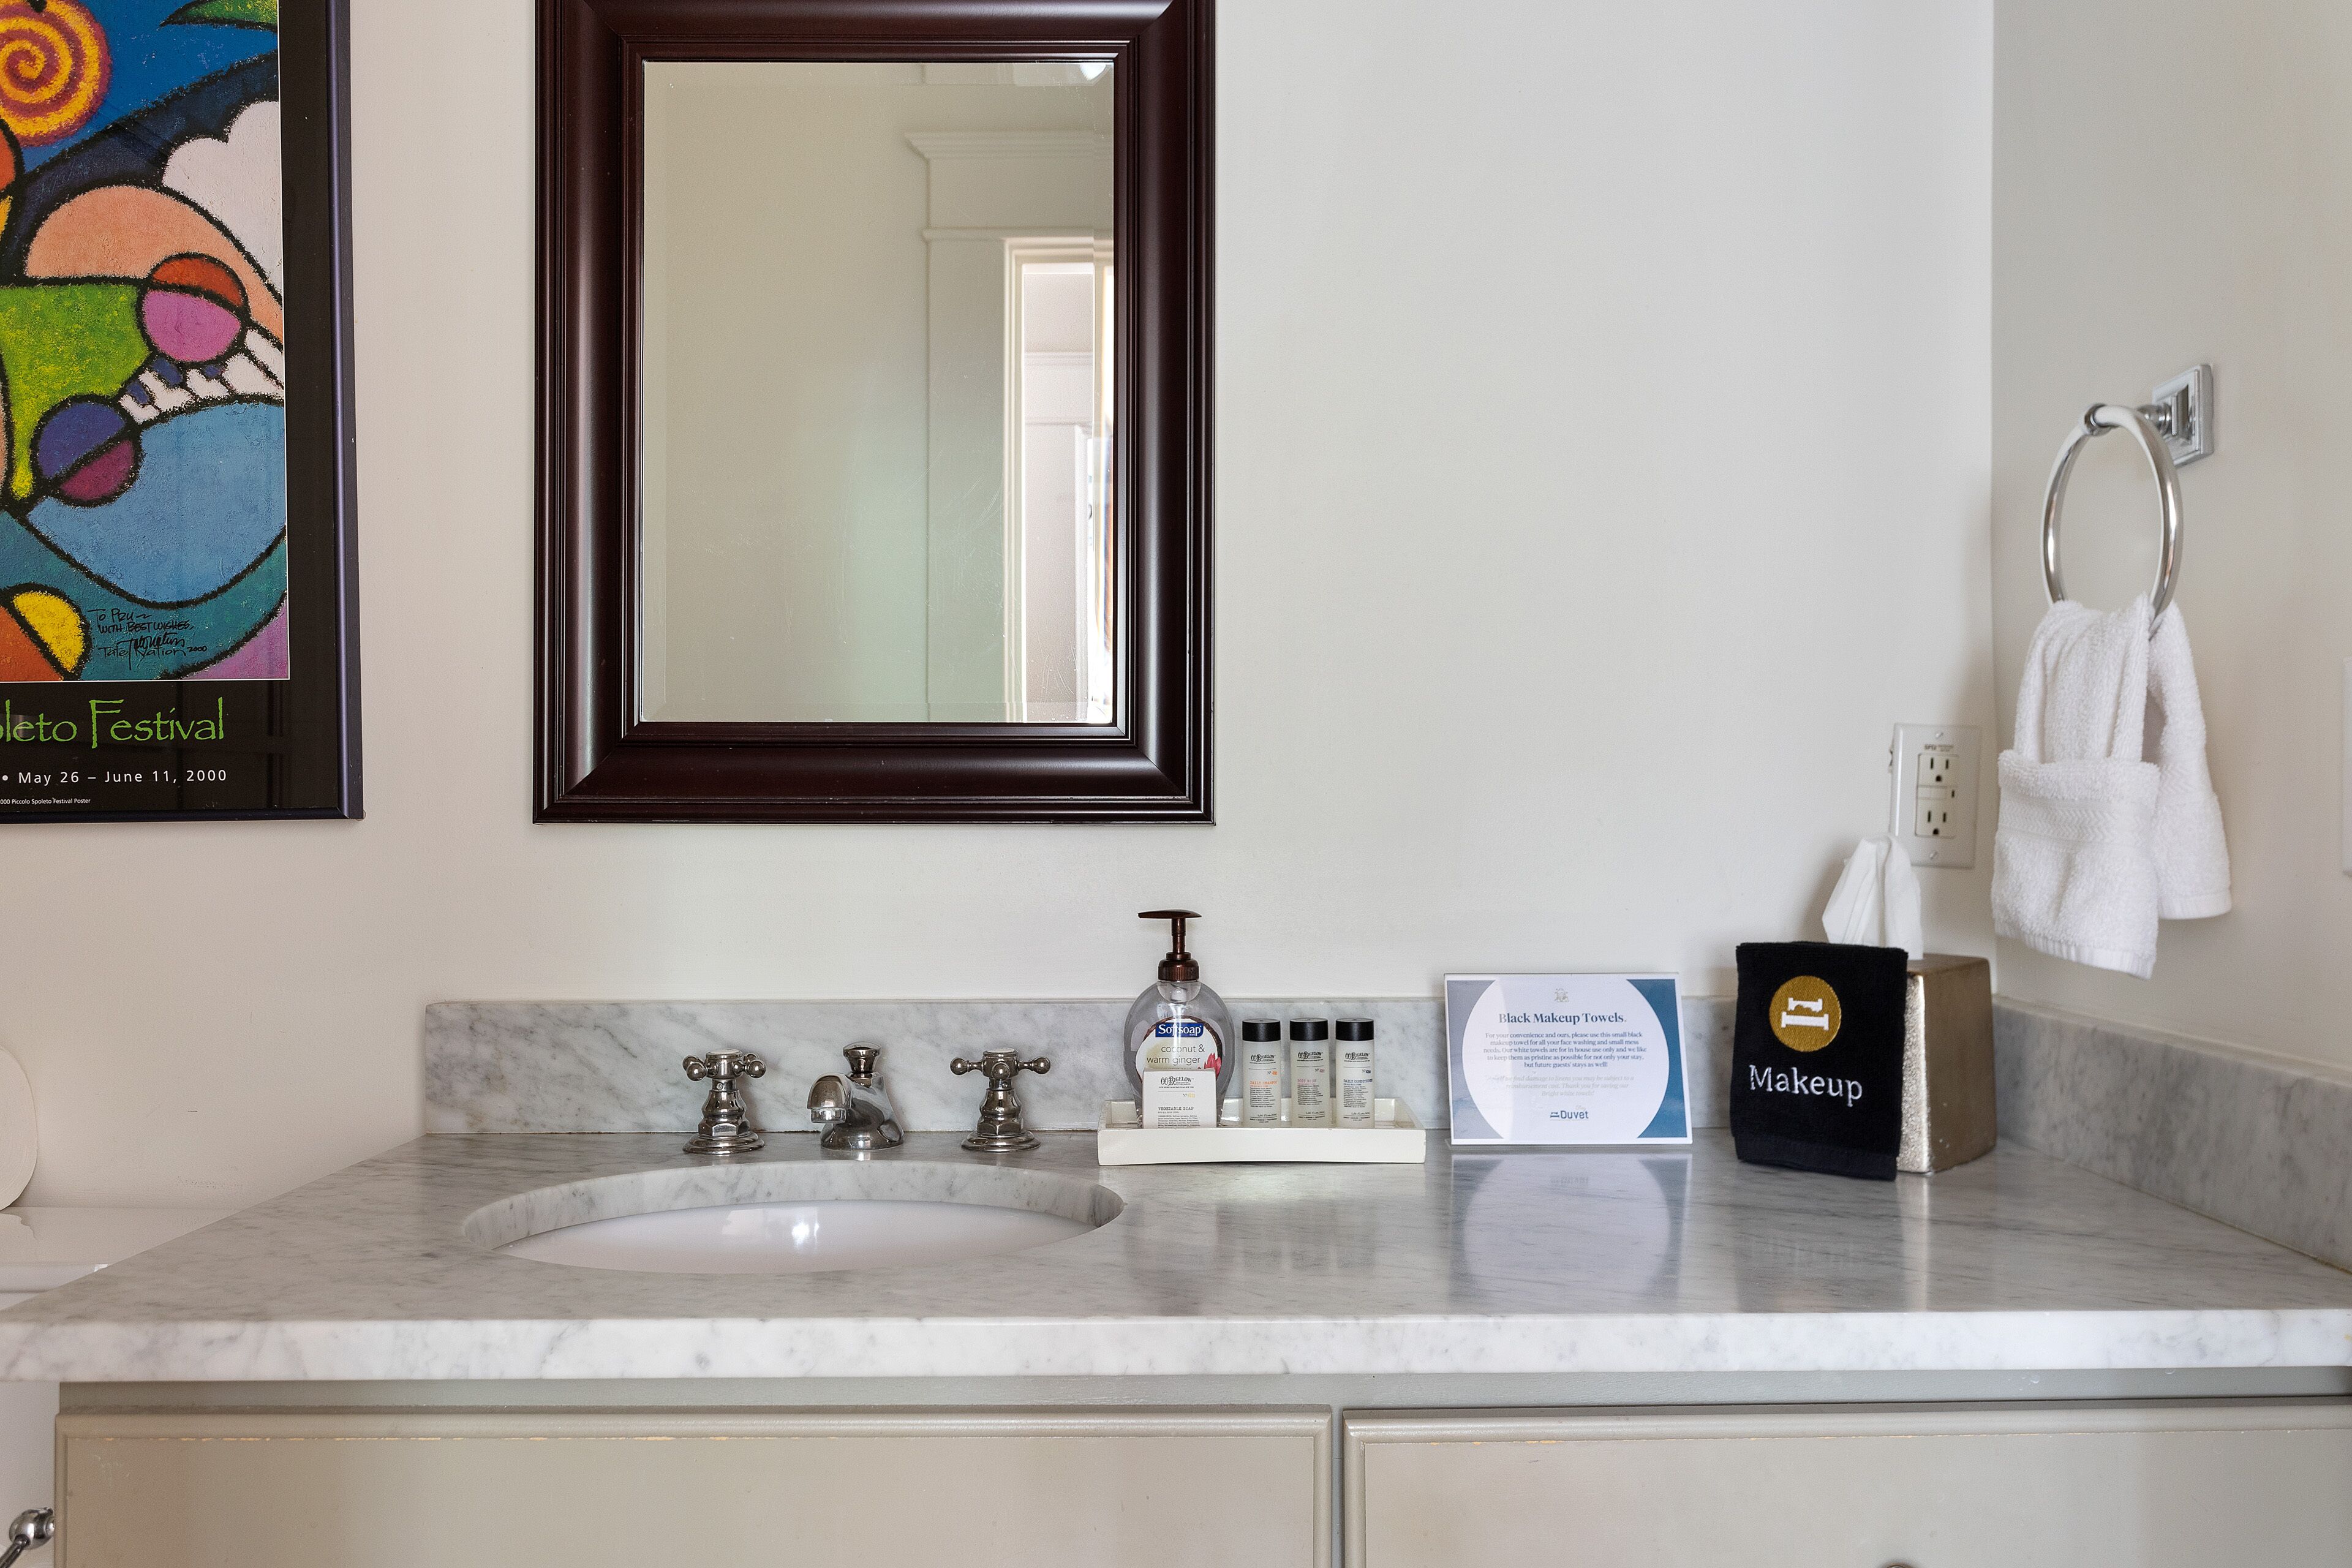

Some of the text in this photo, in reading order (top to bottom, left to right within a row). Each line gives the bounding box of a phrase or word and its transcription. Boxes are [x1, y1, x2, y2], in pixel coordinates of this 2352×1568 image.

[0, 696, 224, 748] leto Festival
[18, 772, 51, 786] May
[60, 771, 79, 783] 26
[105, 771, 142, 783] June
[153, 770, 177, 783] 11,
[186, 769, 227, 782] 2000
[1499, 1012, 1627, 1025] Black Makeup Towels.
[1158, 1023, 1201, 1036] Softsoap
[1198, 1044, 1205, 1052] &
[1172, 1056, 1200, 1066] ginger
[1749, 1065, 1863, 1107] Makeup
[1560, 1110, 1589, 1119] Duvet
